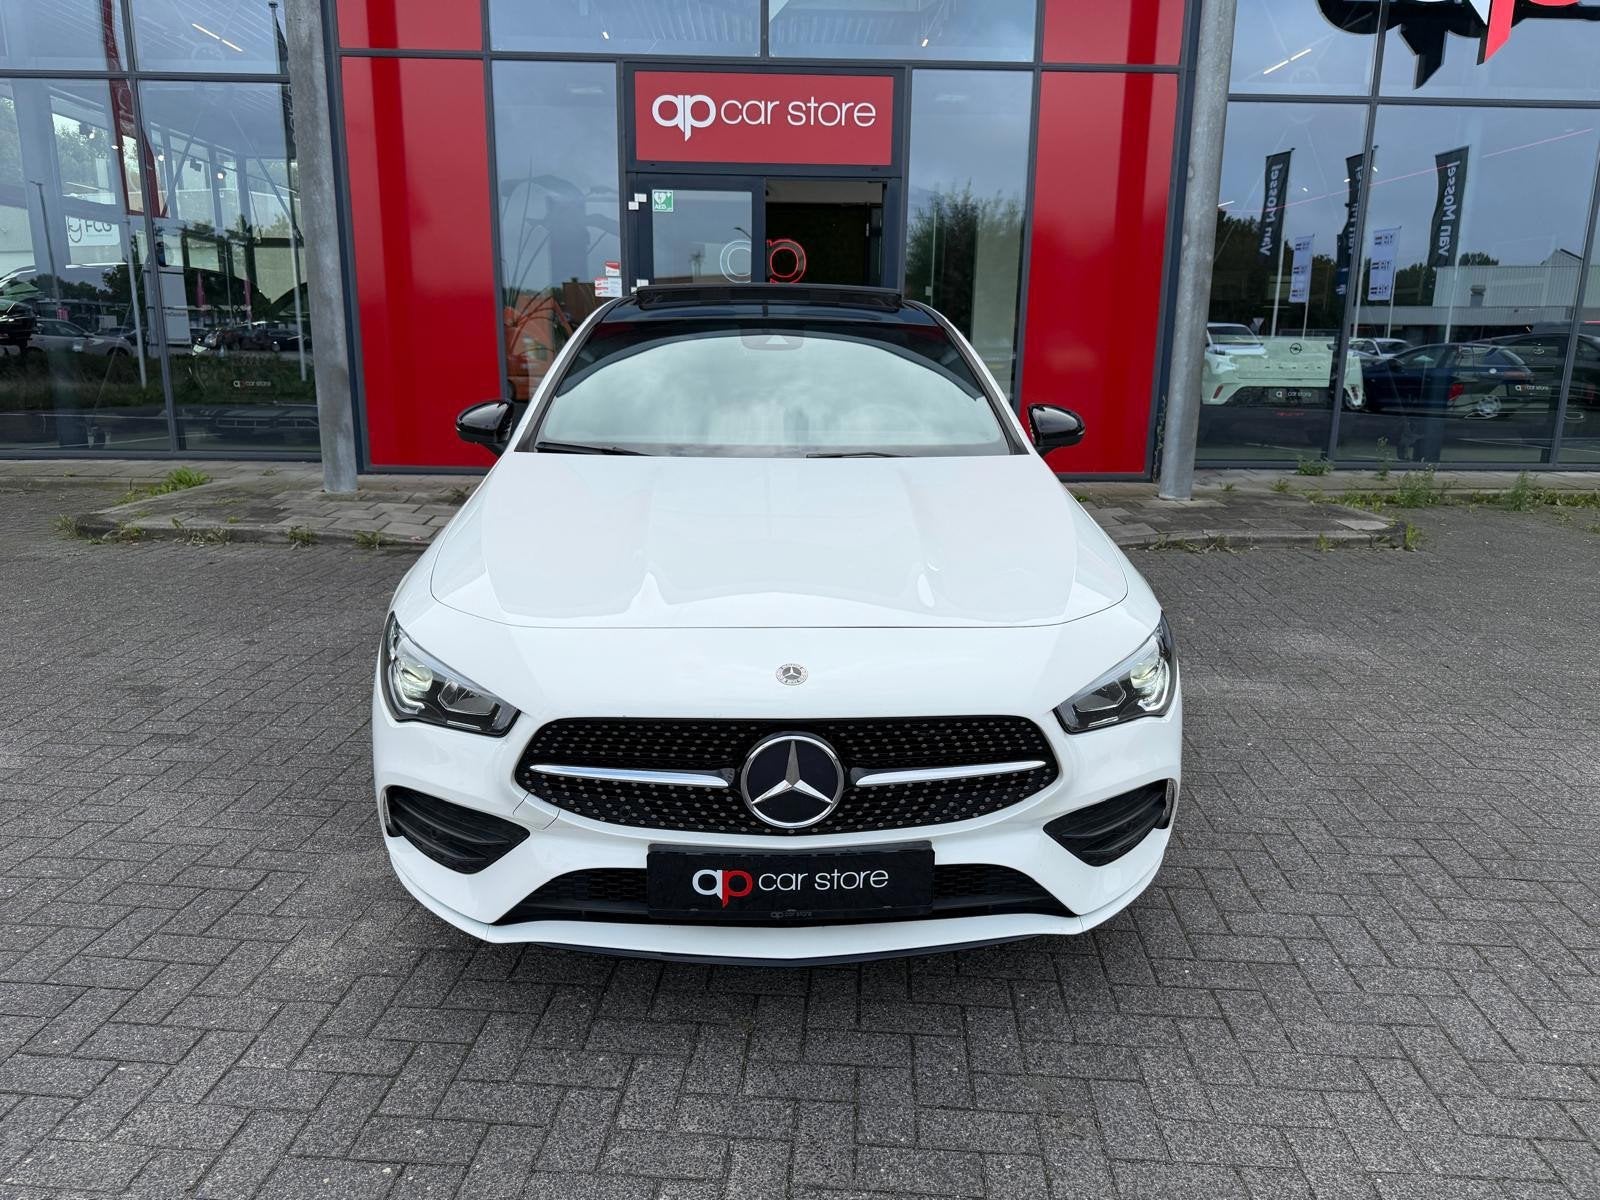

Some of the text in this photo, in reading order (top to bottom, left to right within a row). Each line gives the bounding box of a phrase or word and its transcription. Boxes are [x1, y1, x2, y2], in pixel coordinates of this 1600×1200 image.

[652, 94, 876, 142] ap car store
[692, 869, 889, 908] ap car store
